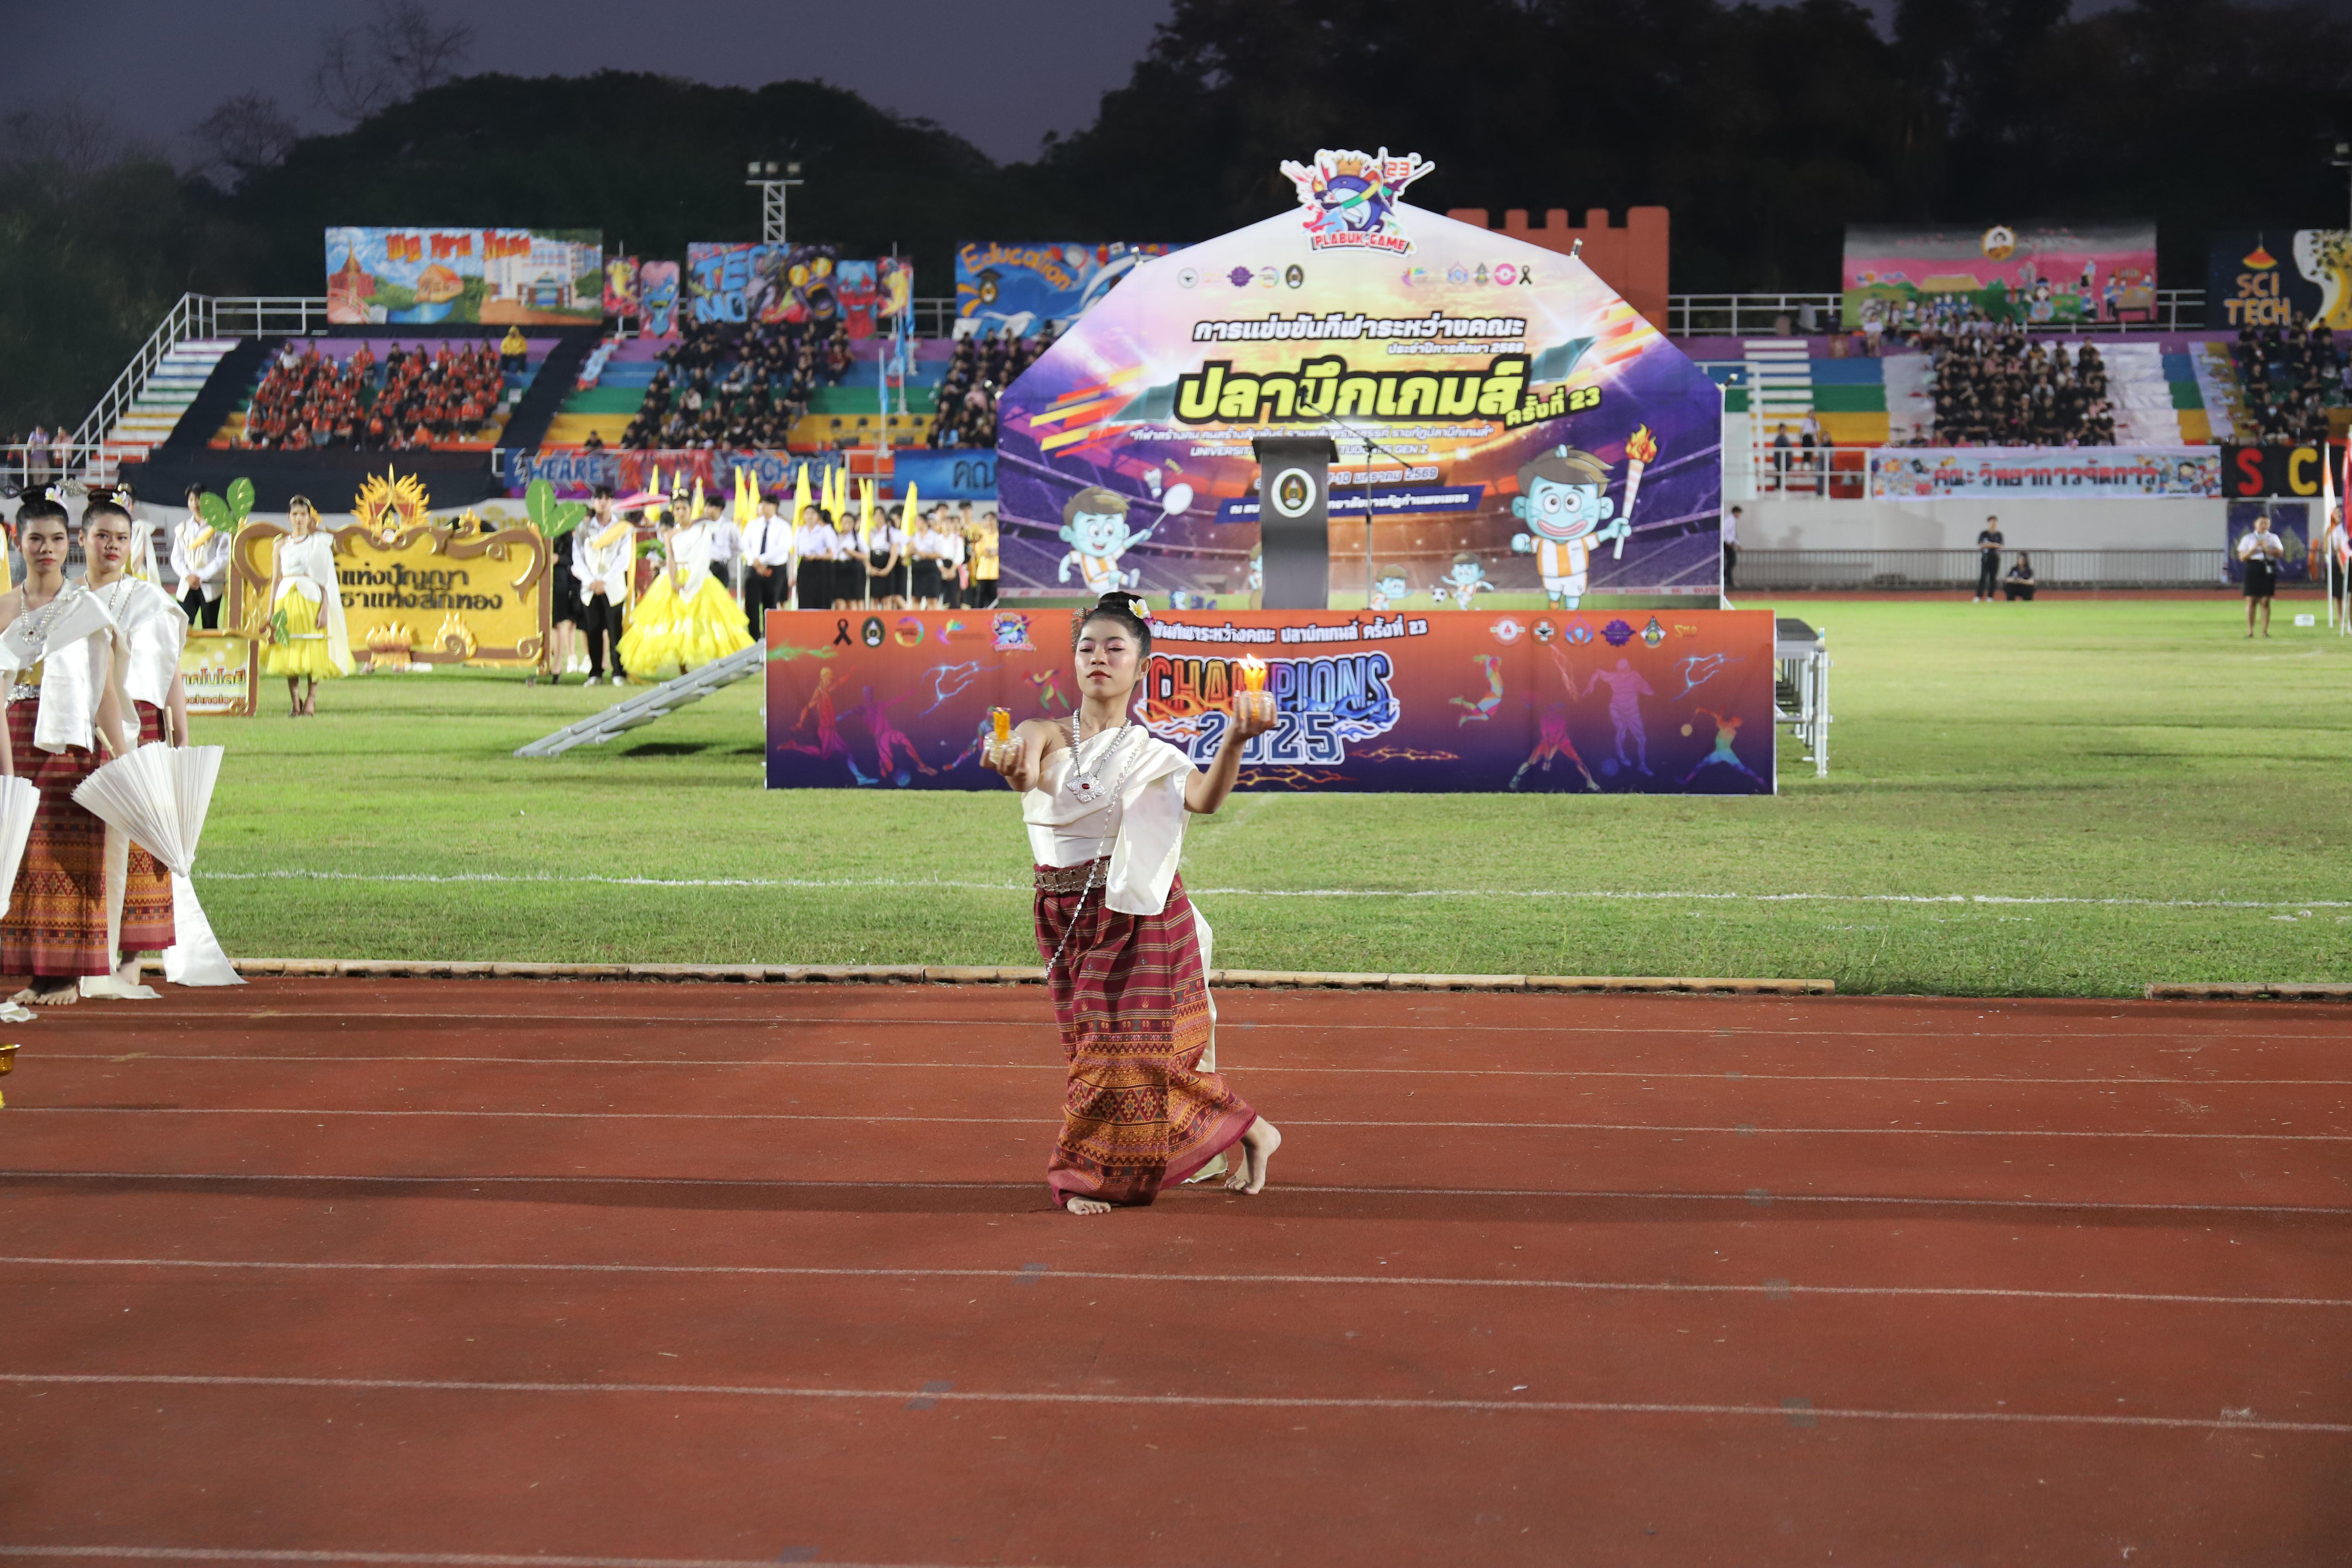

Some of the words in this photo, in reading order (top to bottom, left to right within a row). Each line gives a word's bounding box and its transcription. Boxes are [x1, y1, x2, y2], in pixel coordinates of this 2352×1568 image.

[1386, 161, 1410, 177] 23
[1314, 232, 1364, 247] PLABUK
[1370, 233, 1409, 251] GAME
[2236, 272, 2280, 298] SCI
[2224, 297, 2291, 326] TECH
[1194, 312, 1525, 341] การแข่งขันกีฬาระหว่างคณะ
[1178, 357, 1527, 420] ปลาบึกเกมส์
[1506, 387, 1565, 427] ครั้งที่
[1569, 388, 1601, 411] 23
[1394, 444, 1419, 454] GEN
[1419, 444, 1429, 454] Z
[954, 459, 998, 488] คณ
[1403, 466, 1439, 482] 2569
[1153, 620, 1276, 643] ขันกีฬาระหว่างคณะ
[1363, 614, 1405, 640] ครั้งที่
[1408, 619, 1428, 636] 23
[181, 668, 246, 685] ทคโนโลยี
